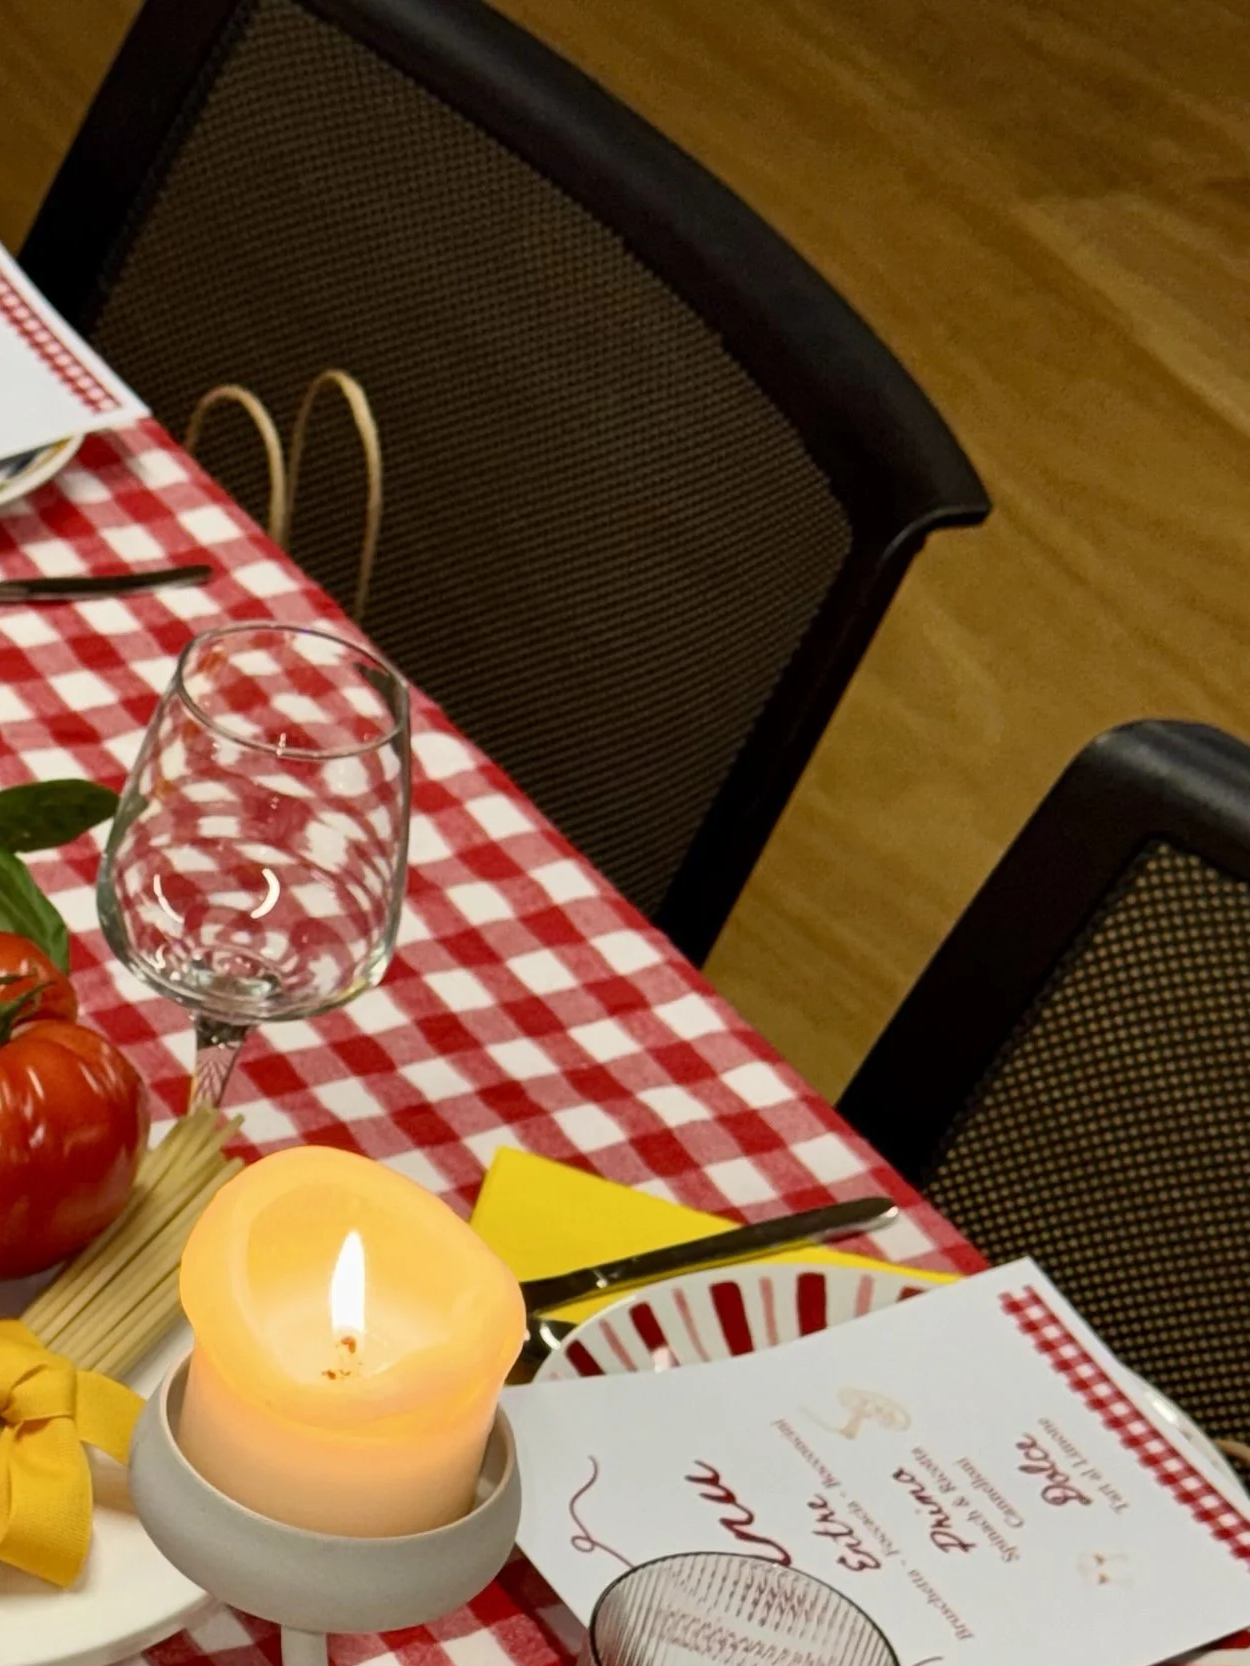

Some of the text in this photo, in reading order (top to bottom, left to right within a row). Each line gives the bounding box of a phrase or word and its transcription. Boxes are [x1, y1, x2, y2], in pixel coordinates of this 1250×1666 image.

[911, 1446, 958, 1494] Ricotta
[955, 1456, 1024, 1529] Cannelloni
[1015, 1432, 1093, 1506] Dolce
[684, 1459, 792, 1568] nu
[807, 1493, 882, 1571] Entre
[892, 1467, 977, 1553] Primo
[966, 1509, 1021, 1563] Spinach
[907, 1568, 974, 1640] Bruschetta
